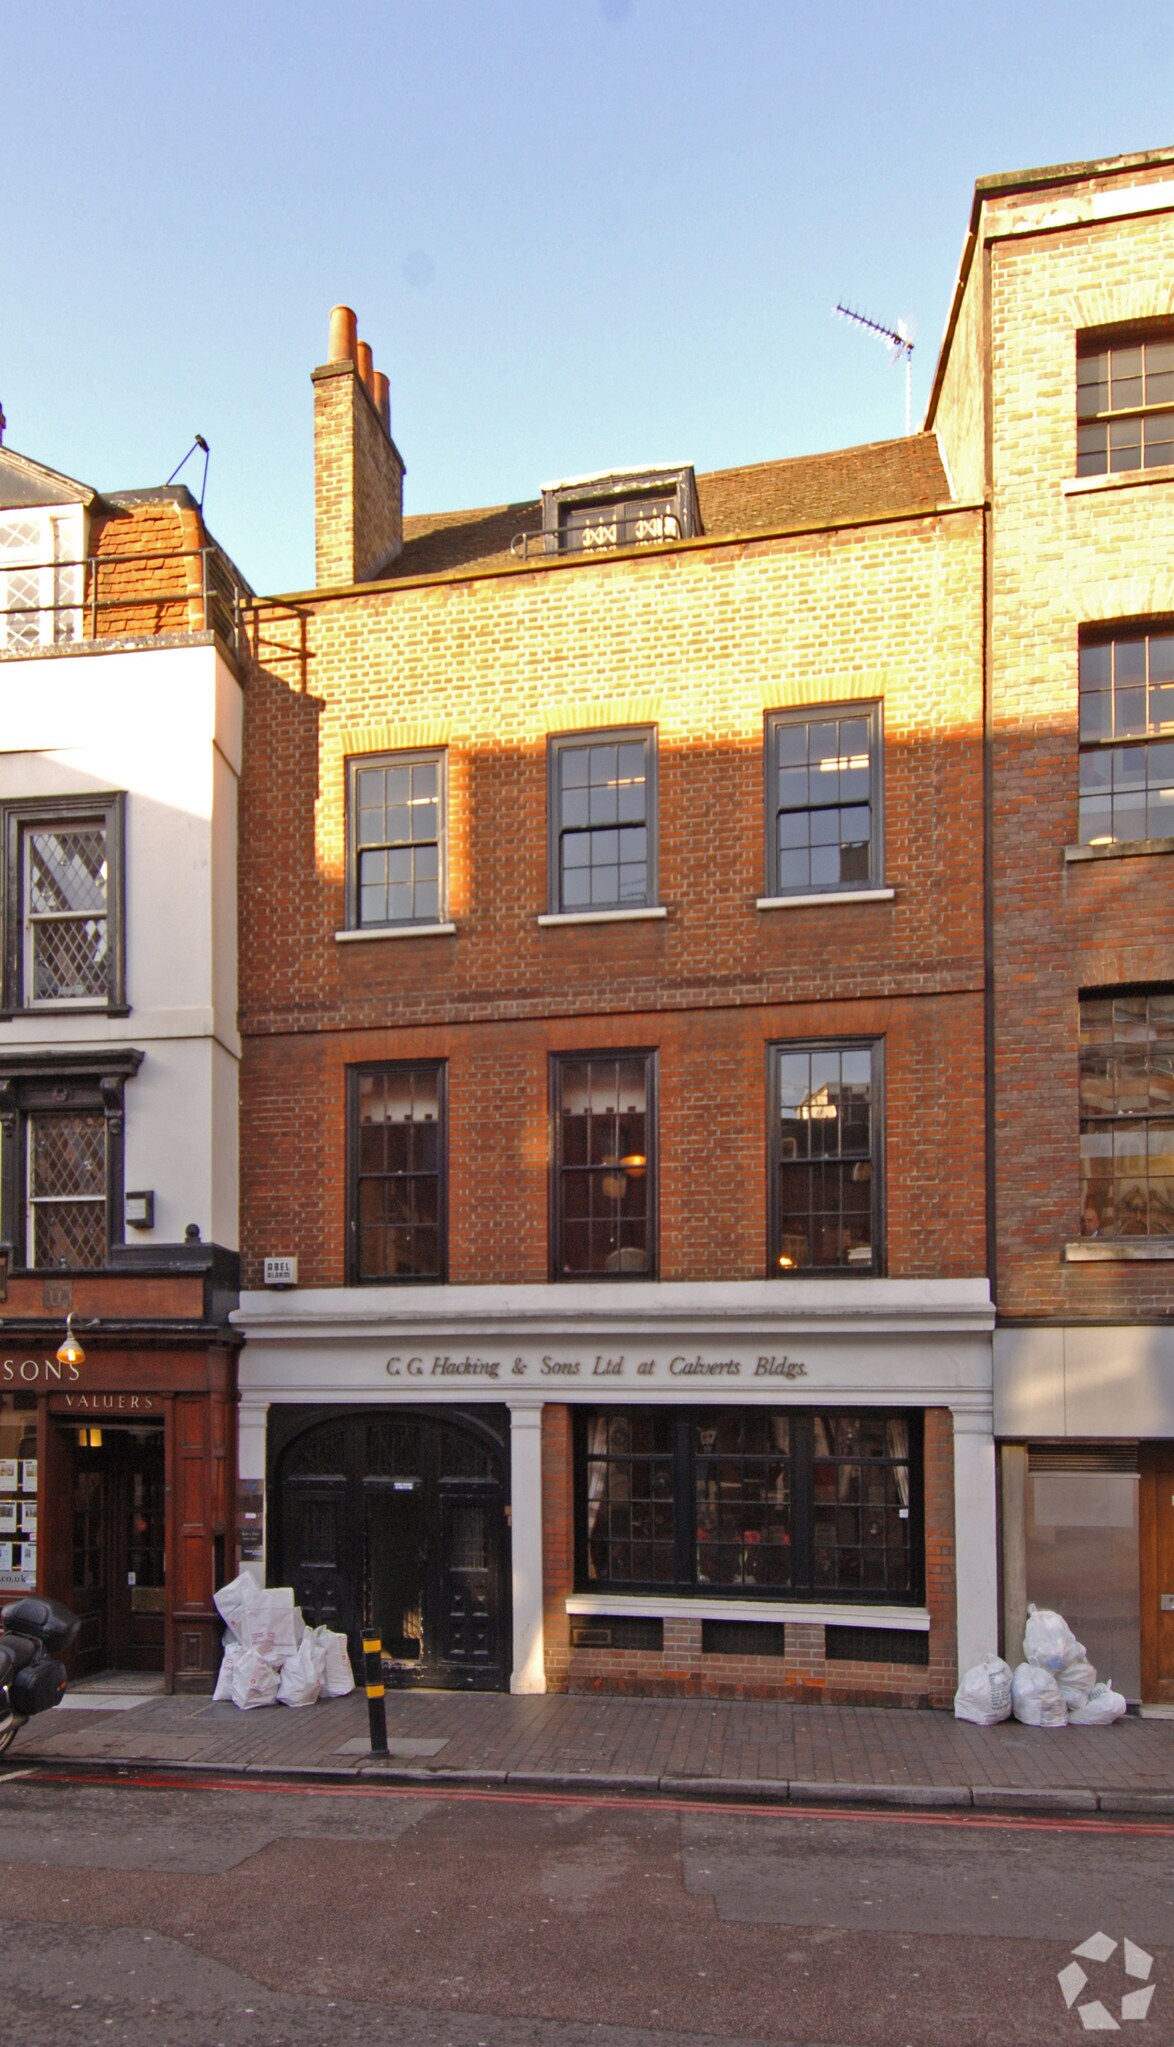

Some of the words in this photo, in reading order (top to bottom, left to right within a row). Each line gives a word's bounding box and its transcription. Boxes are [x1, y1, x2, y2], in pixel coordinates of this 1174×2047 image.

[267, 1262, 289, 1271] ABEL
[3, 1359, 80, 1381] SONS
[430, 1356, 500, 1379] Hacking
[511, 1356, 527, 1375] &
[540, 1356, 581, 1375] Sons
[592, 1356, 625, 1376] Ltd
[636, 1359, 656, 1376] at
[668, 1355, 741, 1376] Calverts
[65, 1394, 153, 1409] VALUERS
